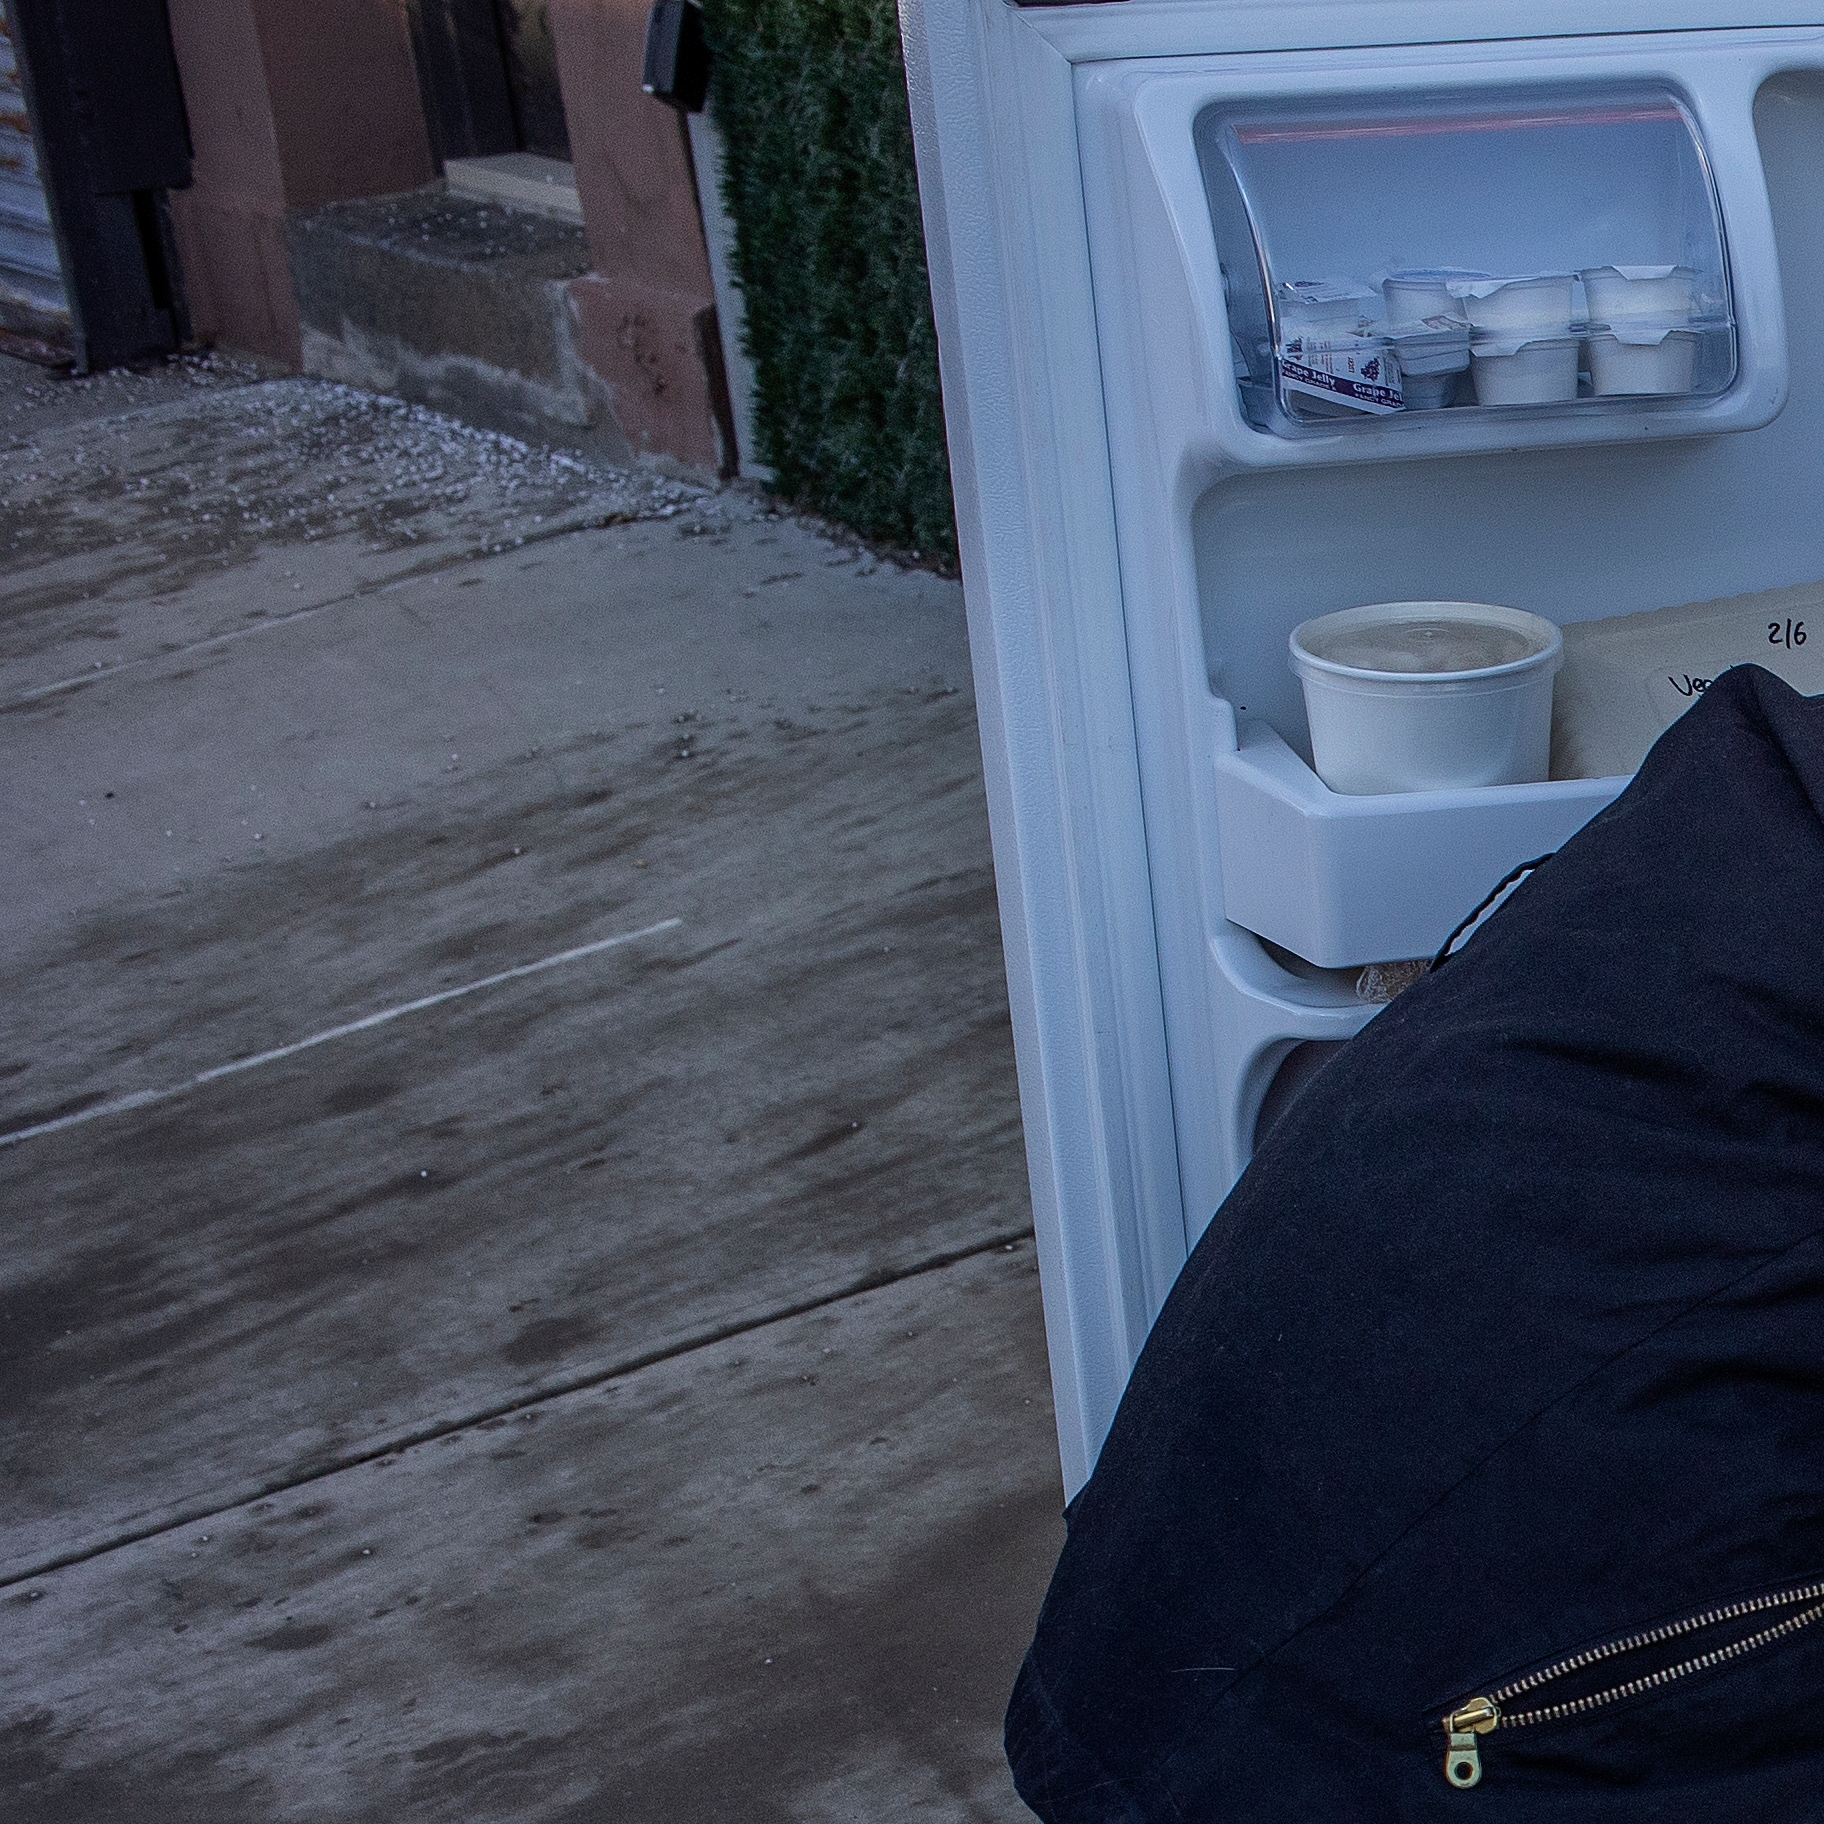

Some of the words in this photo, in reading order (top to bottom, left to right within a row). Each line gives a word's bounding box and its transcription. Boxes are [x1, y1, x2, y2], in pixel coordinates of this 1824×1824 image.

[1311, 371, 1337, 387] Jelly
[1353, 383, 1386, 398] Grape
[1767, 618, 1807, 649] 2/6
